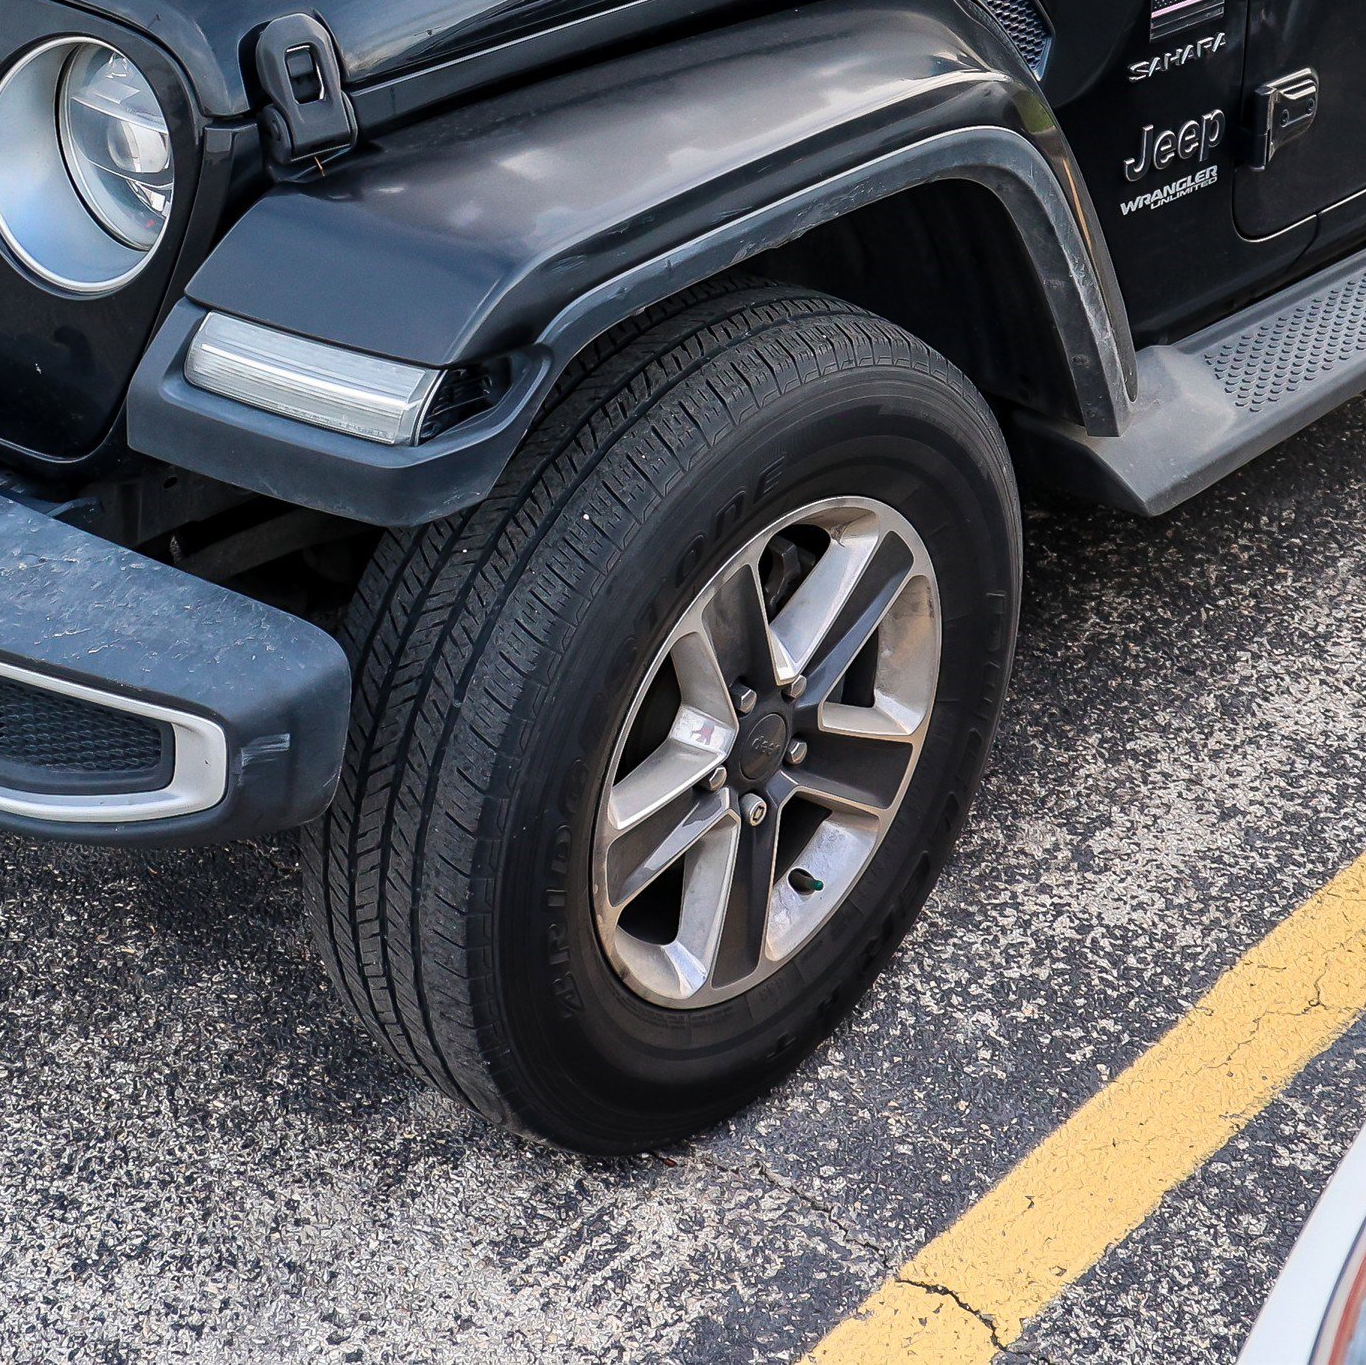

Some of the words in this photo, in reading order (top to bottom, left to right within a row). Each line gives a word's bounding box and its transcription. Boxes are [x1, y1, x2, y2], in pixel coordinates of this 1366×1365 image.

[1127, 31, 1226, 83] SAHARA
[1123, 109, 1226, 182] Jeep
[1120, 165, 1218, 216] WRANGLER
[1150, 176, 1218, 210] UNLIMITED
